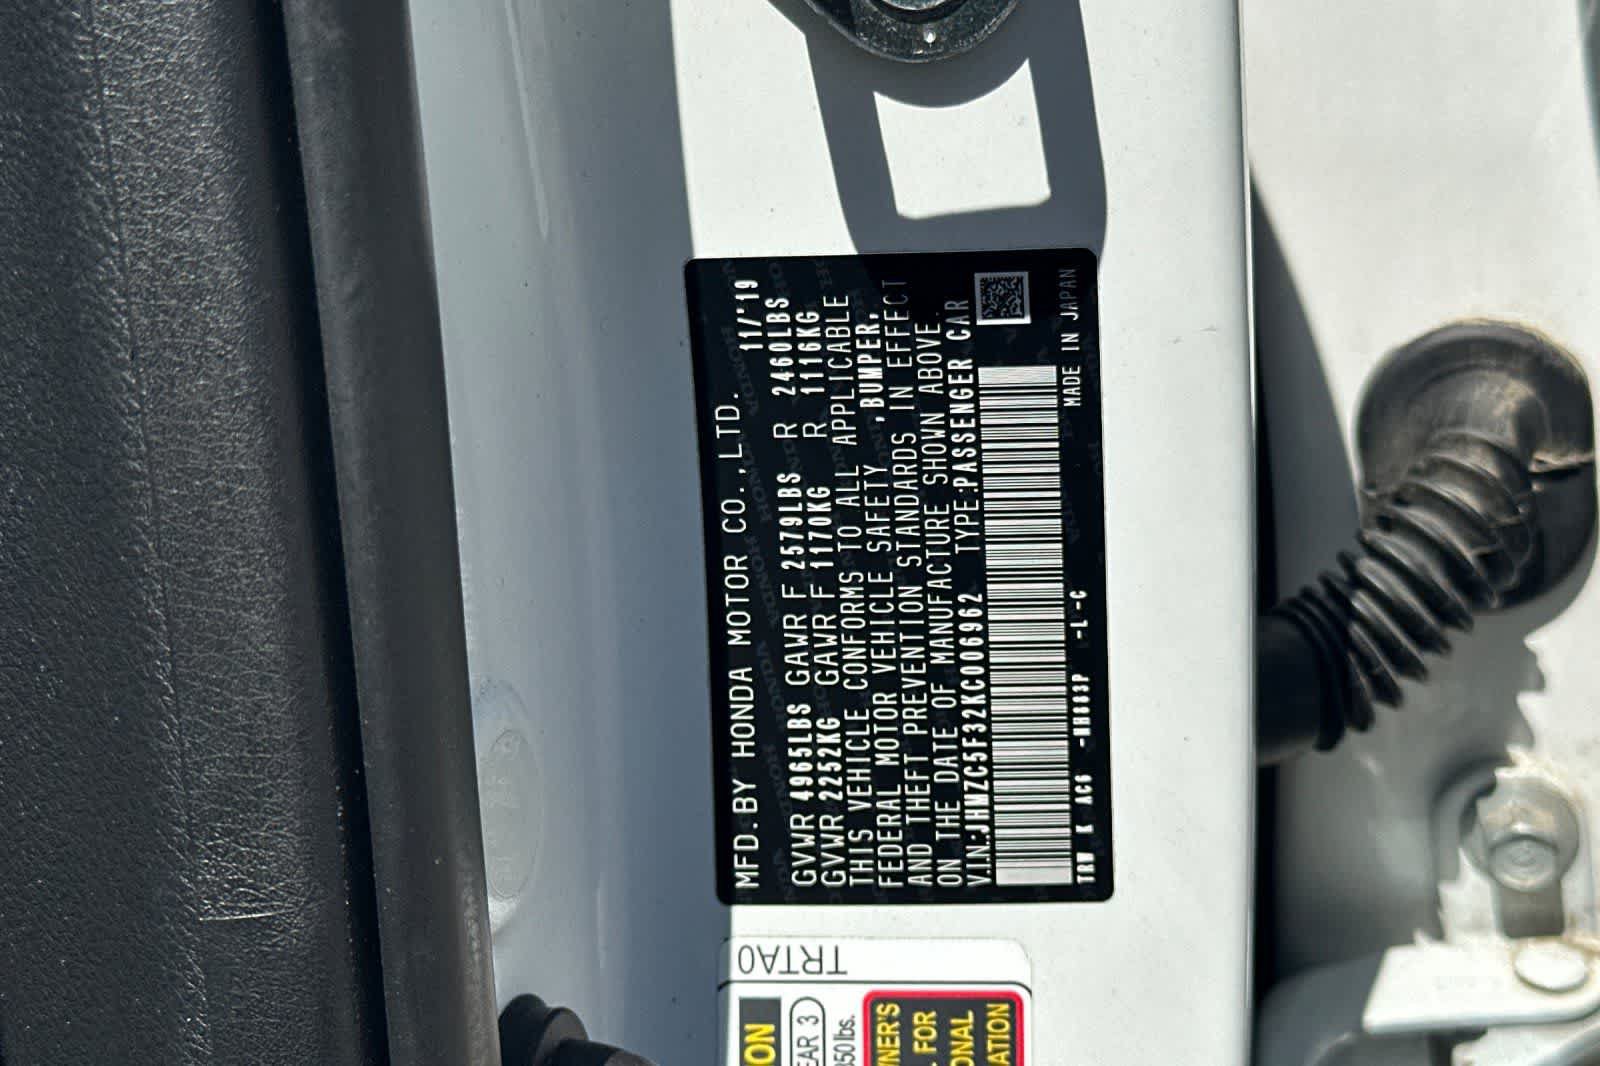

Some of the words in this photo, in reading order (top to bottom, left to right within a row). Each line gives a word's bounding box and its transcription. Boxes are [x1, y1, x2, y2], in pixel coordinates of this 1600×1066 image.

[883, 280, 912, 367] EFFECT
[945, 301, 971, 340] CAR
[1060, 270, 1078, 320] JAPAN
[764, 298, 796, 396] 2460LBS
[795, 311, 825, 394] 1116KG
[823, 296, 857, 445] APPLICABLE
[914, 313, 944, 394] ABOVE.
[1061, 333, 1080, 351] IN
[888, 386, 915, 410] IN
[1062, 366, 1081, 406] MADE
[773, 423, 798, 438] R
[802, 422, 828, 438] R
[920, 413, 948, 485] SHOWN
[776, 472, 806, 570] 2579LBS
[834, 464, 860, 507] ALL
[862, 464, 892, 552] SAFETY
[891, 433, 922, 567] STANDARDS
[806, 486, 834, 569] 1170KG
[837, 526, 862, 552] TO
[724, 555, 751, 645] MOTOR
[782, 584, 807, 598] F
[810, 584, 835, 598] F
[924, 504, 955, 664] MANUFACTURE
[782, 614, 810, 685] GAWR
[812, 614, 840, 685] GAWR
[838, 572, 868, 690] CONFORMS
[868, 571, 896, 674] VEHICLE
[898, 586, 928, 734] PREVENTION
[930, 682, 957, 708] OF
[728, 667, 755, 758] HONDA
[872, 692, 900, 766] MOTOR
[786, 704, 814, 801] 4965LBS
[816, 717, 843, 801] 2252KG
[844, 708, 872, 812] VEHICLE
[932, 726, 960, 783] DATE
[904, 753, 931, 825] THEFT
[934, 800, 960, 841] THE
[732, 778, 760, 888] MFD.BY
[790, 814, 817, 886] GVWR
[819, 814, 846, 888] GVWR
[848, 829, 874, 887] THIS
[876, 784, 904, 888] FEDERAL
[906, 844, 933, 886] AND
[1076, 824, 1094, 834] K
[936, 859, 963, 887] ON
[1076, 852, 1096, 884] TRW
[797, 1014, 819, 1025] 3
[912, 1011, 938, 1055] FOR
